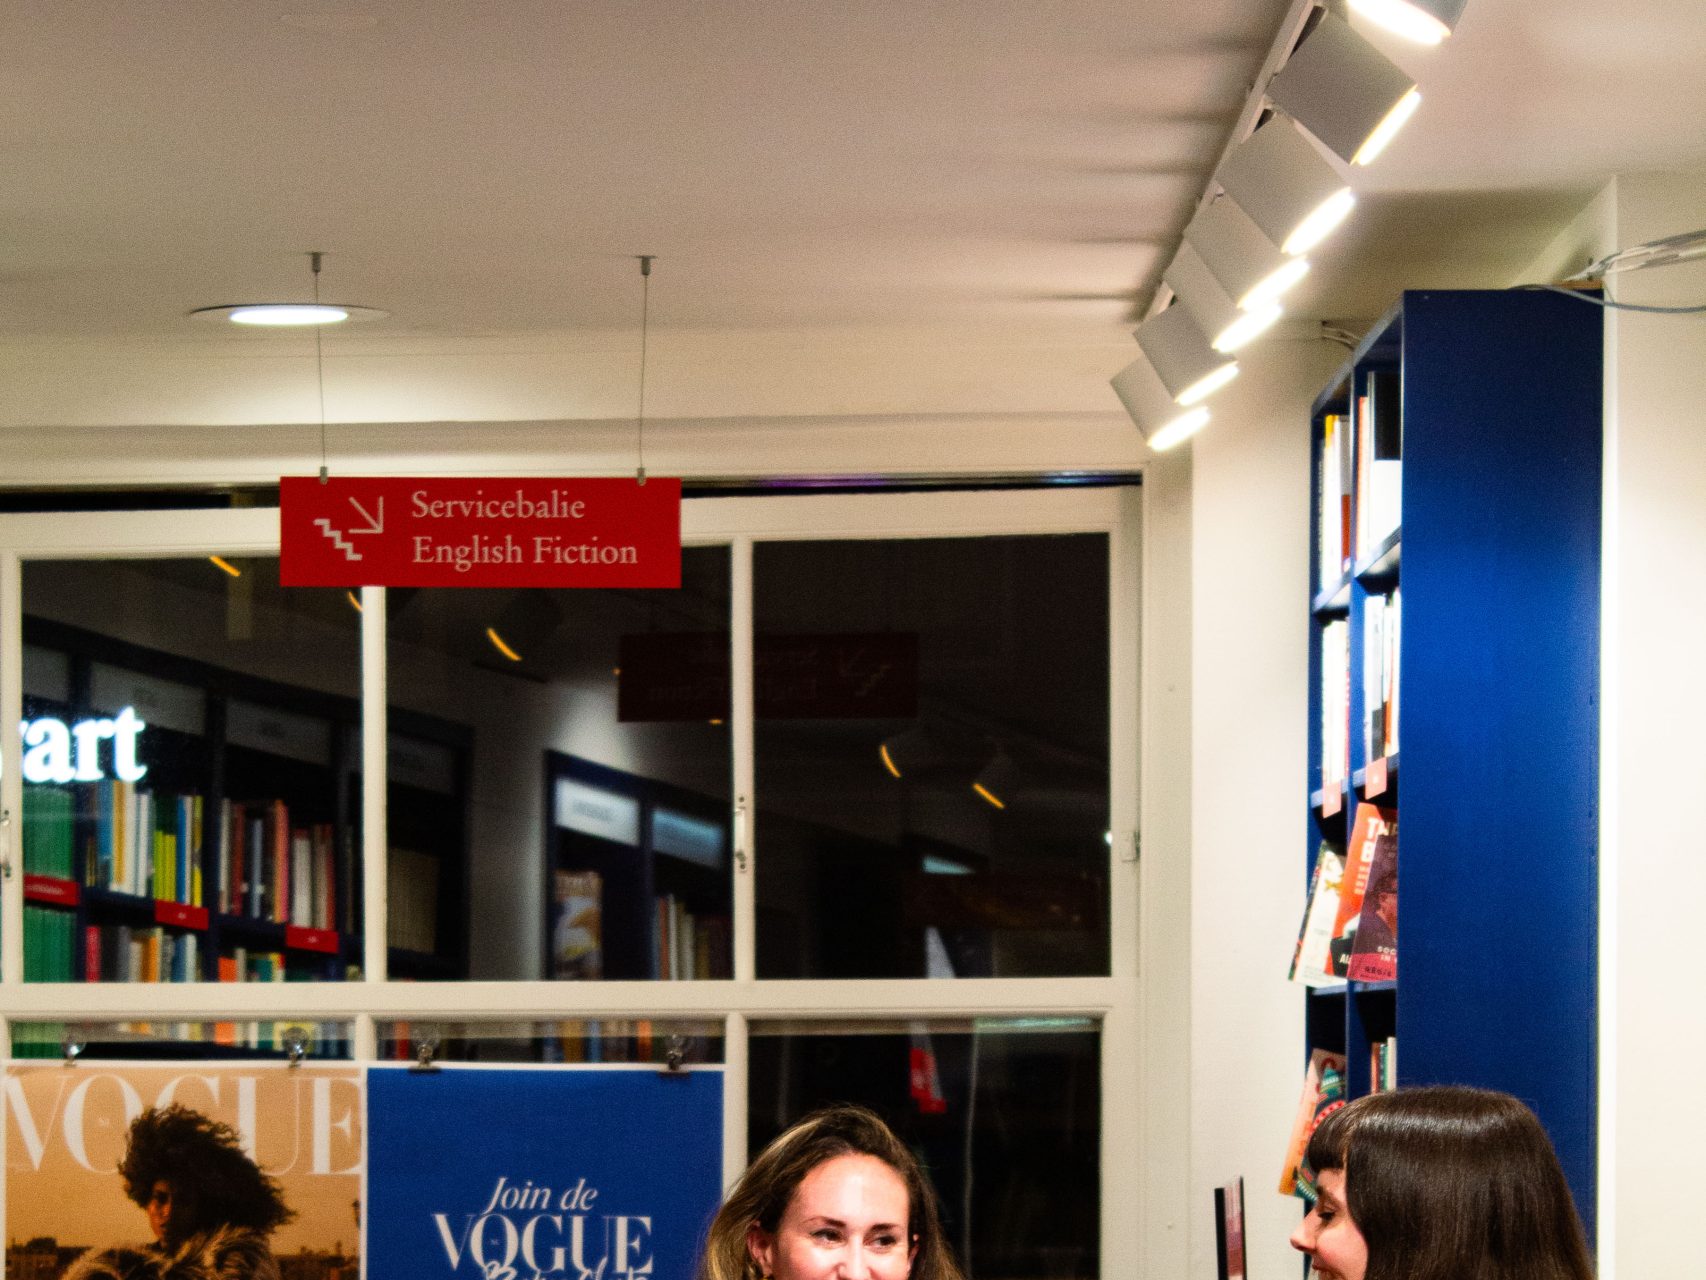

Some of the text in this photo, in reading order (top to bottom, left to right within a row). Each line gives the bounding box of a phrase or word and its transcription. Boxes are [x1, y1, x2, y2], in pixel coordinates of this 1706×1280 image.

[411, 489, 586, 519] Servicebalie
[412, 534, 638, 572] English Fiction
[20, 705, 148, 784] art
[480, 1176, 599, 1216] Join de
[431, 1213, 653, 1274] VOGUE
